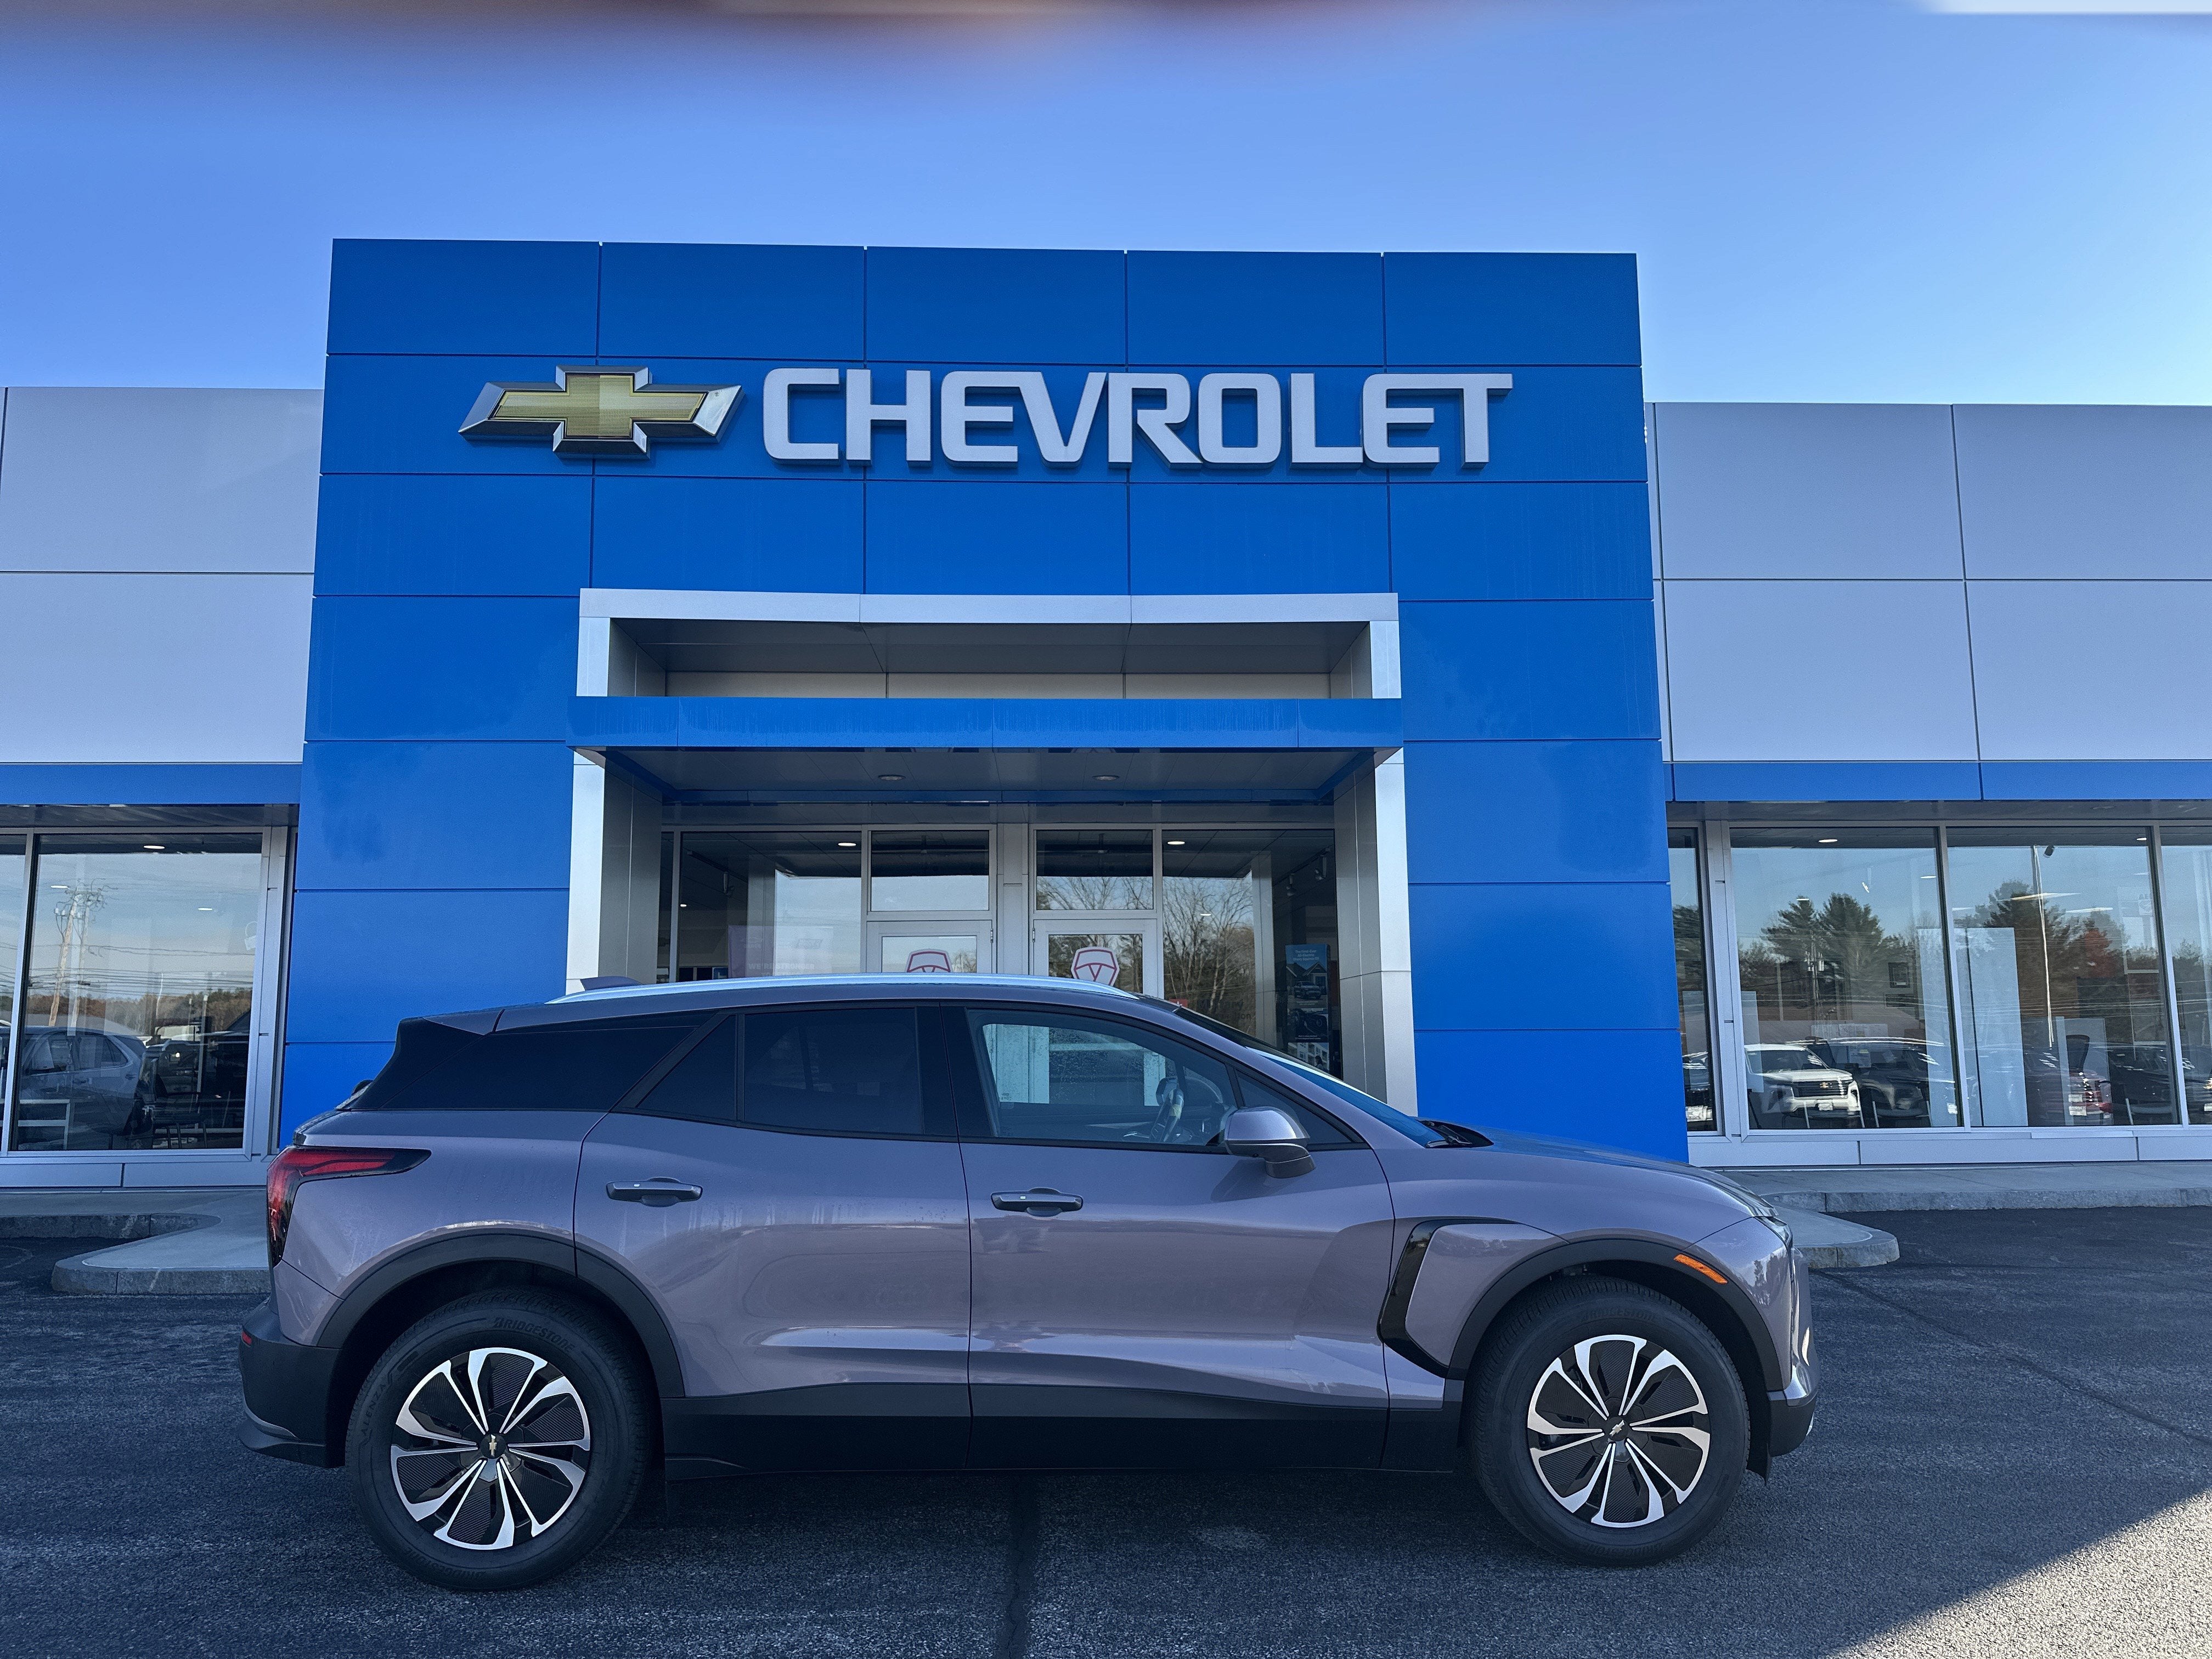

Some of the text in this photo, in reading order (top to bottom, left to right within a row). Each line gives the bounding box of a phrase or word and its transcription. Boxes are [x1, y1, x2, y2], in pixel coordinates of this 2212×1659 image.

[763, 368, 1514, 467] CHEVROLET
[1581, 1306, 1658, 1323] BRIDGESTONE
[491, 1317, 575, 1352] BRIDGESTONE
[361, 1384, 386, 1436] ALENZA
[404, 1547, 487, 1580] BRIDGESTONE
[1582, 1542, 1662, 1558] BRIDGESTONE
